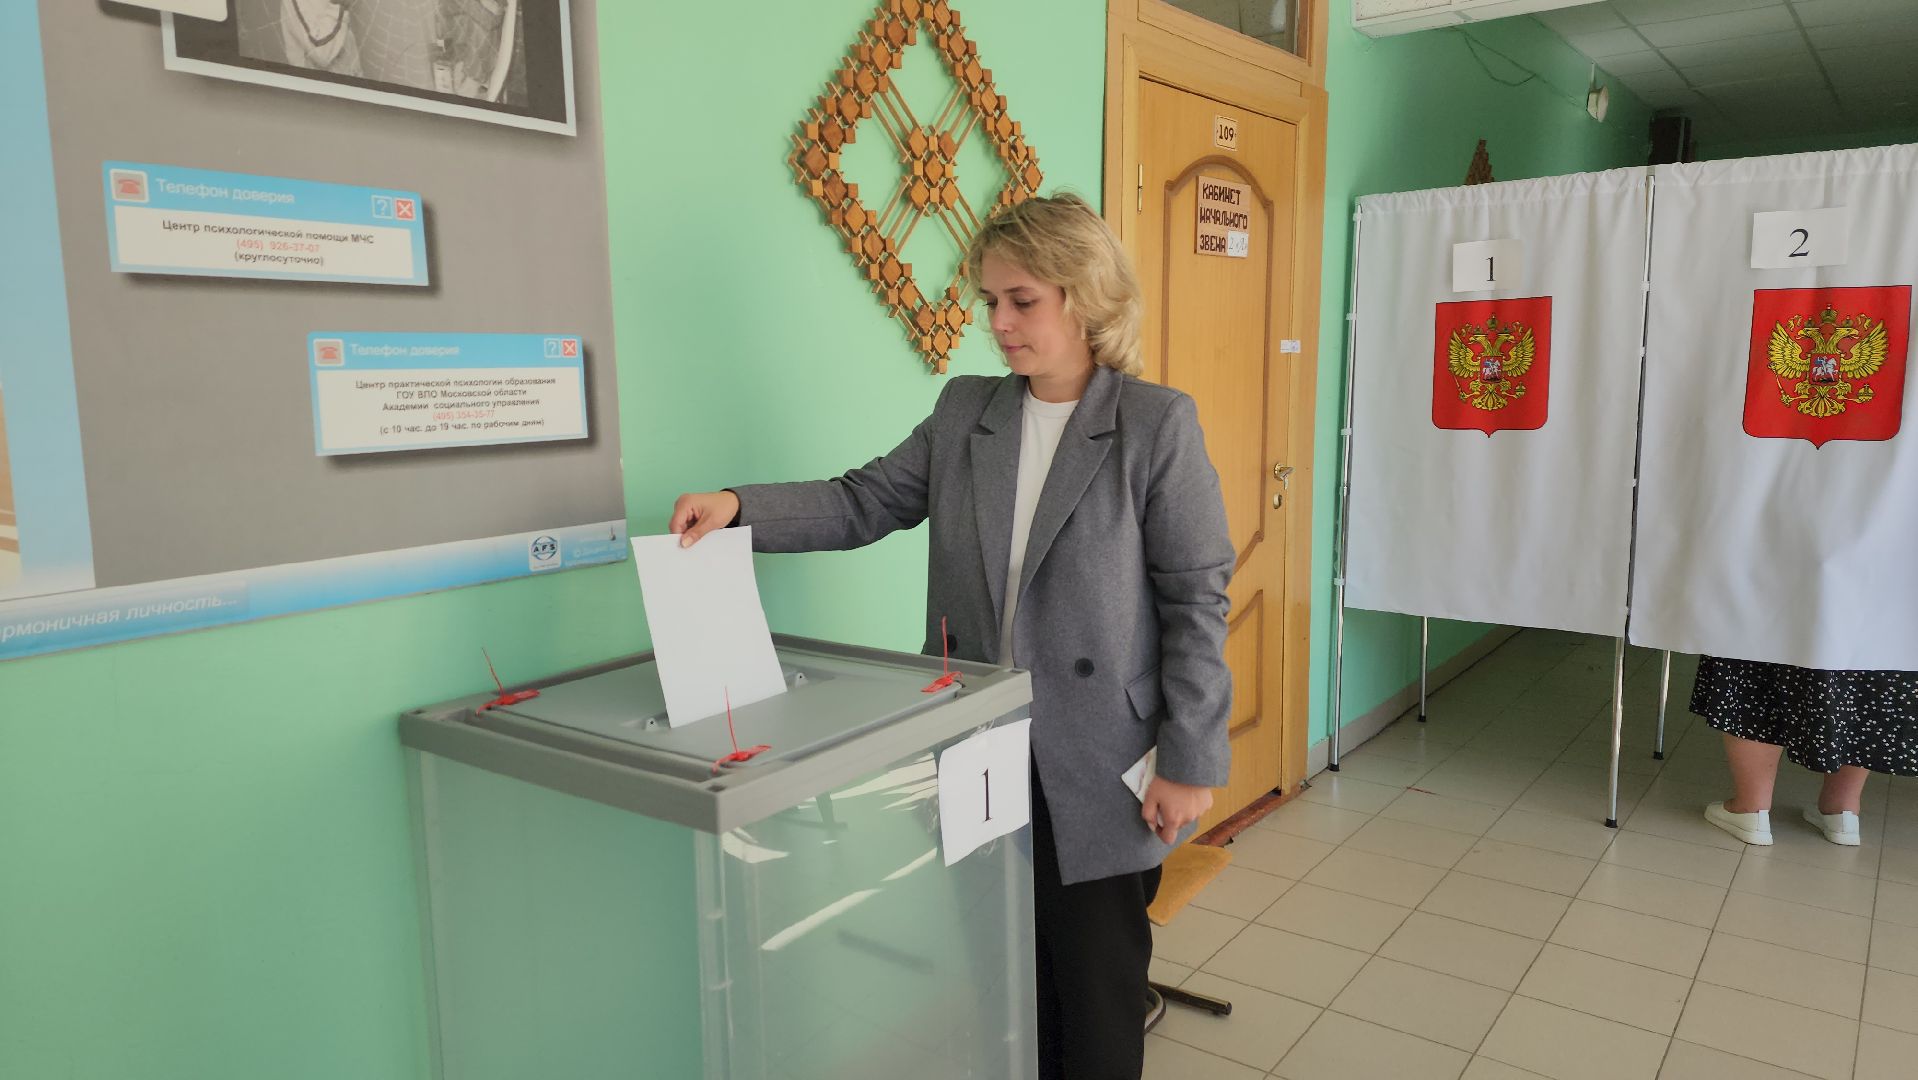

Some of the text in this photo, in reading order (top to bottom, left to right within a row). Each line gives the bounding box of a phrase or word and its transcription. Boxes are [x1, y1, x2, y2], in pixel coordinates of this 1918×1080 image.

[1218, 123, 1234, 142] 109
[155, 178, 295, 205] Телефон доверия
[1203, 181, 1241, 205] КАБИНЕТ
[1200, 206, 1248, 230] НАЧАЛЬНОГО
[162, 219, 375, 244] Центр психологической помощи МЧС
[1200, 234, 1226, 252] ЗВЕНА
[1788, 228, 1810, 257] 2
[234, 251, 325, 266] (круглосуточно)
[1485, 256, 1497, 282] 1
[350, 343, 460, 357] Телефон доверия
[355, 377, 557, 389] Центр практической психологии образования
[396, 388, 527, 399] ГОУ ВПО Московской области
[382, 398, 540, 412] Академии социального управления
[425, 424, 437, 433] до
[440, 422, 449, 431] 19
[451, 423, 469, 431] час.
[483, 419, 519, 430] рабочим
[521, 418, 545, 427] дням)
[533, 543, 556, 553] AFS
[0, 609, 121, 642] рмоничная
[982, 768, 993, 823] 1
